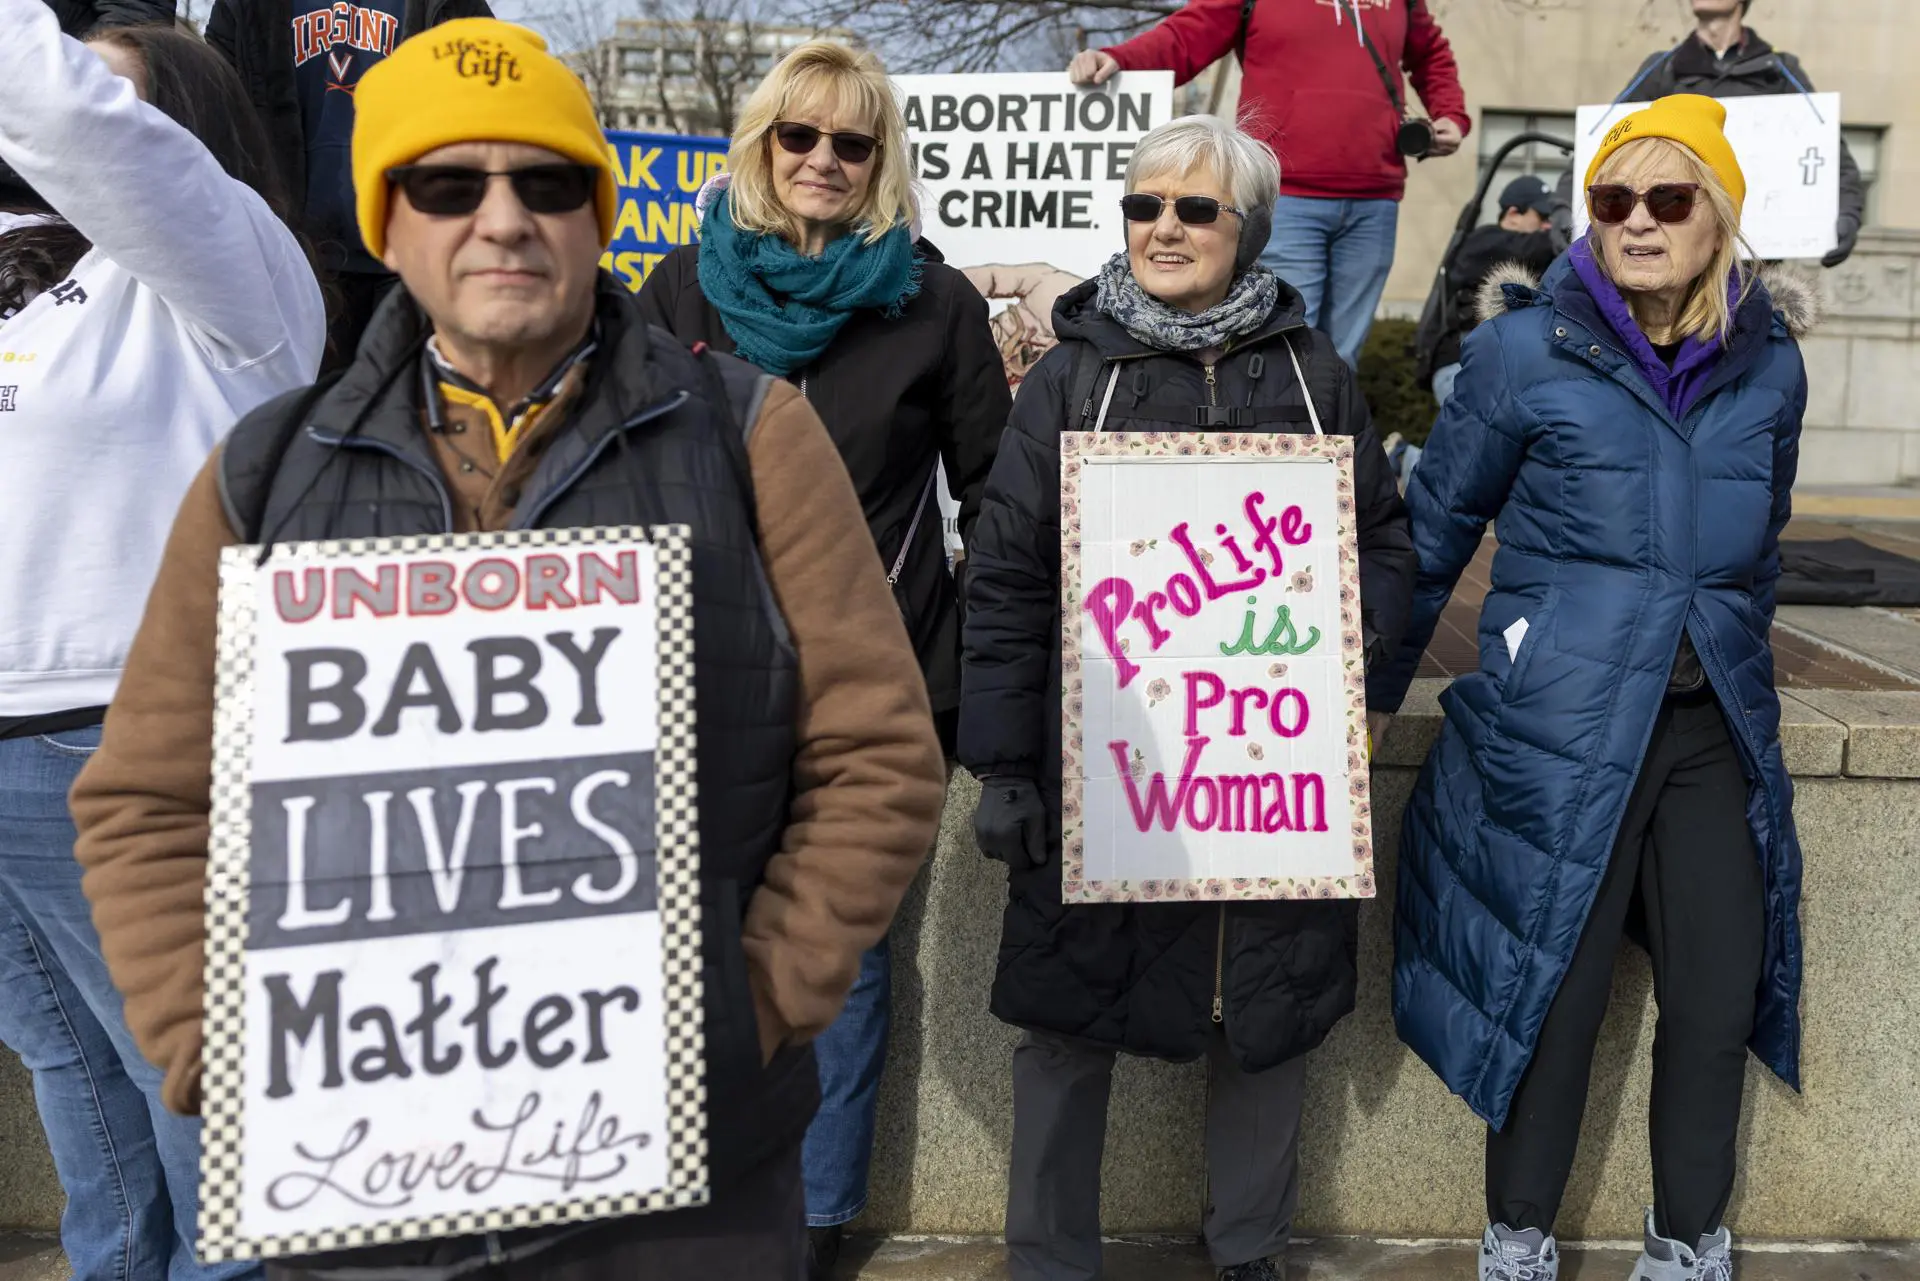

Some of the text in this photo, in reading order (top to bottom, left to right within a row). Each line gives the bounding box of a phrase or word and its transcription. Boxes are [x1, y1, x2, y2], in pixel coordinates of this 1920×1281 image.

[903, 92, 1152, 132] ABORTION
[961, 142, 993, 180] A
[1006, 141, 1138, 180] HATE
[938, 189, 1100, 229] CRIME.
[273, 550, 640, 623] UNBORN
[1219, 595, 1321, 655] is
[281, 627, 622, 743] BABY
[1181, 671, 1310, 738] Pro
[1108, 736, 1329, 834] Woman
[277, 769, 639, 930] LIVES
[262, 956, 641, 1099] Matter
